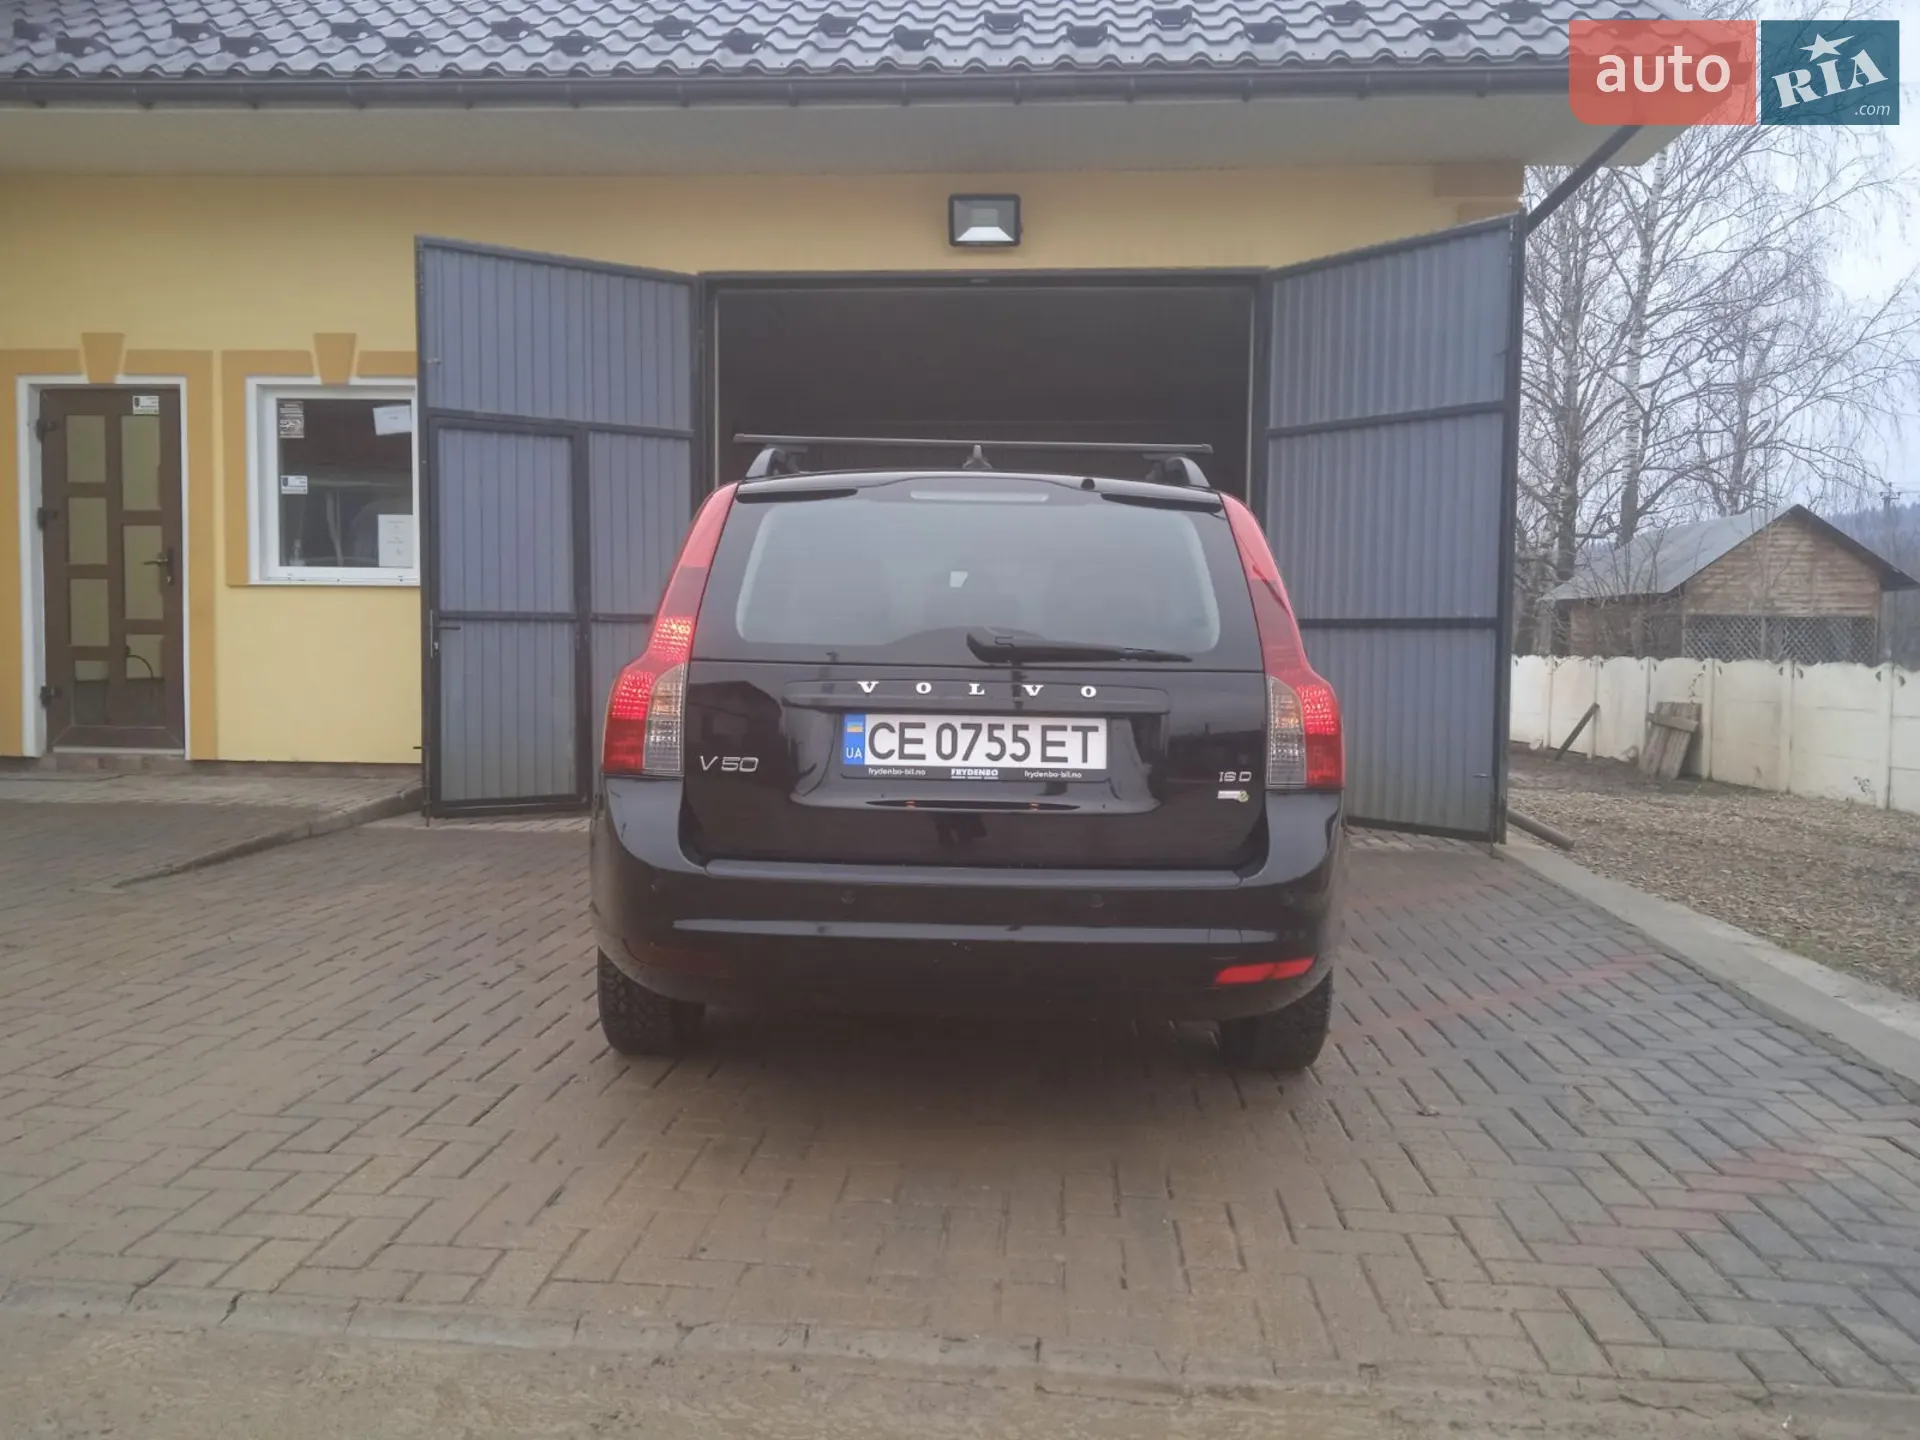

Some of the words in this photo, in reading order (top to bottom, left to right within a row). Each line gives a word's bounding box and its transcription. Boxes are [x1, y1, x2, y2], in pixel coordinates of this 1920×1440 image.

[857, 680, 1097, 698] VOLVO
[868, 722, 926, 760] CE
[936, 723, 1031, 762] 0755
[1041, 726, 1099, 763] ET
[846, 747, 862, 759] UA
